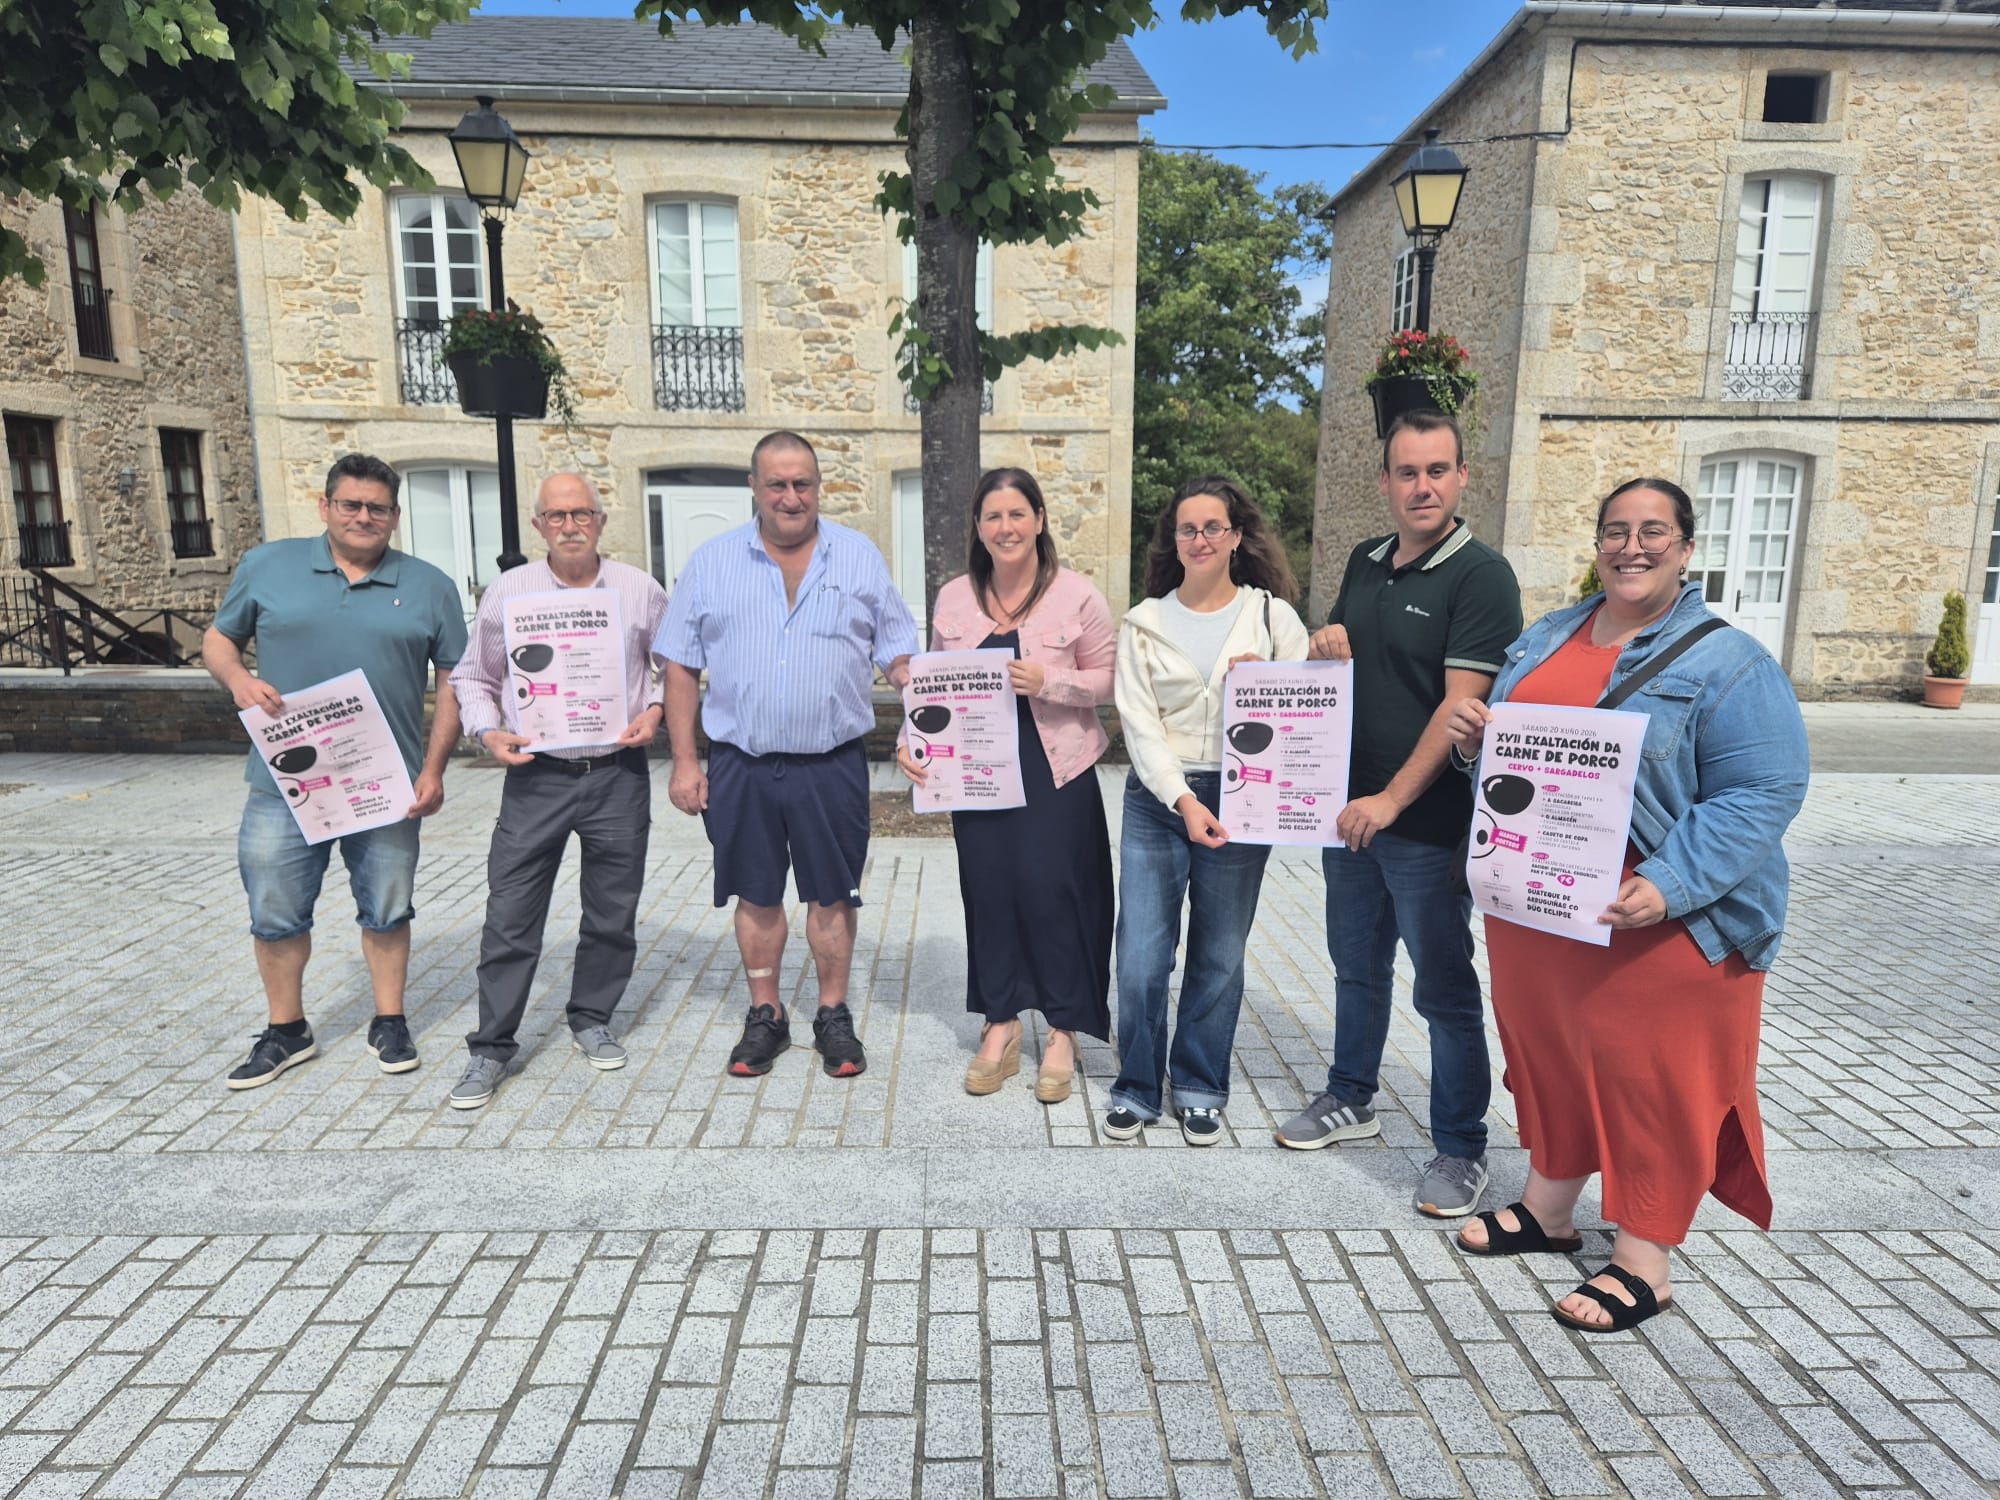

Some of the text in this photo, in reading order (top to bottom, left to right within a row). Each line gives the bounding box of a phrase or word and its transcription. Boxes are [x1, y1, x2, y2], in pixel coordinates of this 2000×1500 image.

[537, 610, 592, 621] EXALTACIÓN
[596, 610, 608, 618] DA
[516, 620, 608, 632] CARNE DE PORCO
[934, 671, 988, 682] EXALTACIÓN
[992, 672, 1002, 680] DA
[914, 682, 1002, 694] CARNE DE PORCO
[1235, 685, 1337, 696] XVII EXALTACIÓN DA
[1236, 698, 1337, 708] CARNE DE PORCO
[285, 701, 344, 725] EXALTACIÓN
[346, 696, 360, 705] DA
[267, 724, 304, 743] CARNE
[306, 716, 322, 727] DE
[324, 704, 363, 721] PORCO
[1522, 724, 1548, 732] SÁBADO
[1560, 727, 1579, 735] XUÑO
[1496, 732, 1621, 754] XVII EXALTACIÓN DA
[1496, 746, 1619, 769] CARNE DE PORCO
[1508, 763, 1534, 772] CERVO
[1544, 767, 1600, 780] SARGADELOS
[1551, 815, 1577, 823] ALMACÉN
[1528, 888, 1561, 899] GUATEQUE
[1527, 903, 1572, 919] DÚO ECLIPSE
